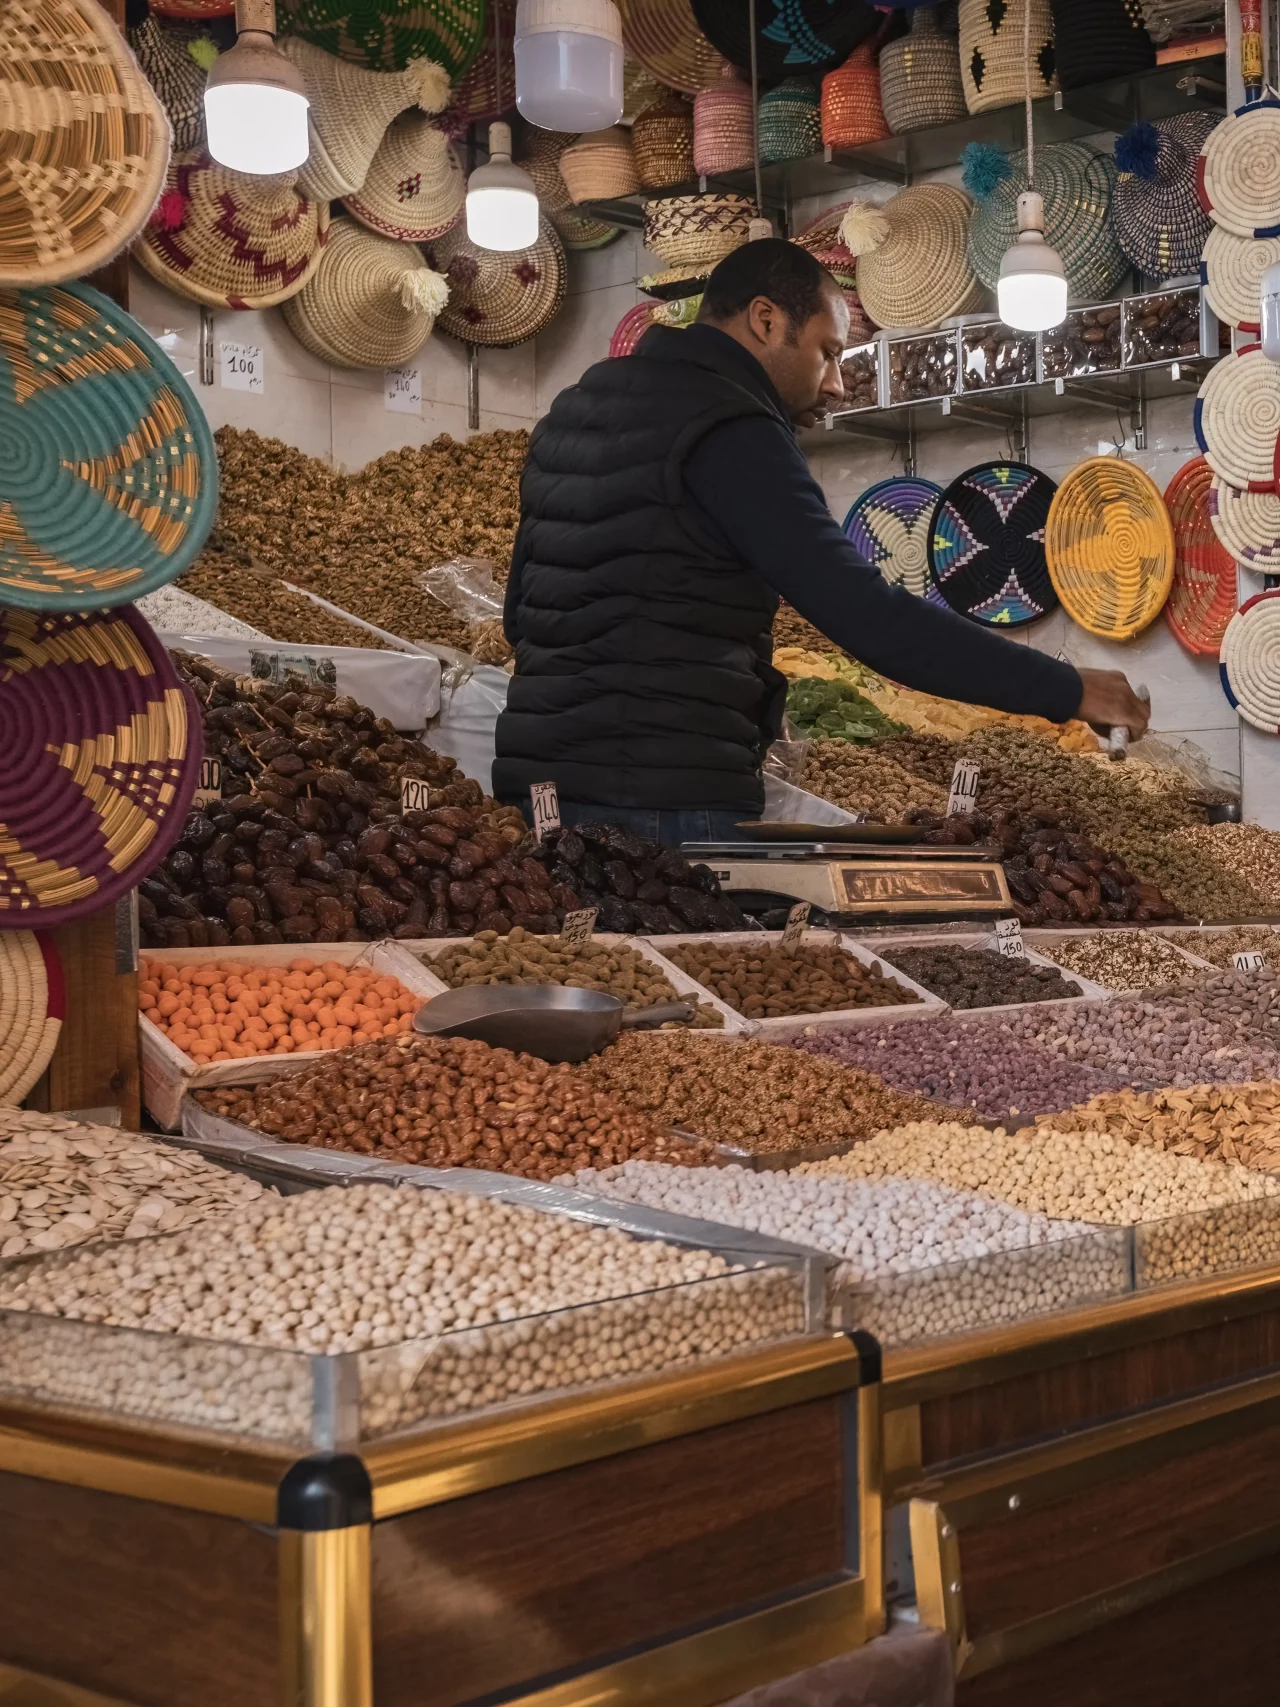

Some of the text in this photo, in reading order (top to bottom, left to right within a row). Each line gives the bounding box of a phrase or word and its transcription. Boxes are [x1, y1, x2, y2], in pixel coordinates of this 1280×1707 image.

[228, 356, 254, 374] 100
[395, 380, 410, 392] 140
[197, 759, 220, 790] 00
[952, 770, 979, 798] 140
[403, 781, 430, 810] 120
[534, 794, 559, 823] 140
[952, 800, 967, 812] DH
[565, 929, 588, 942] 150
[1003, 942, 1022, 955] 150
